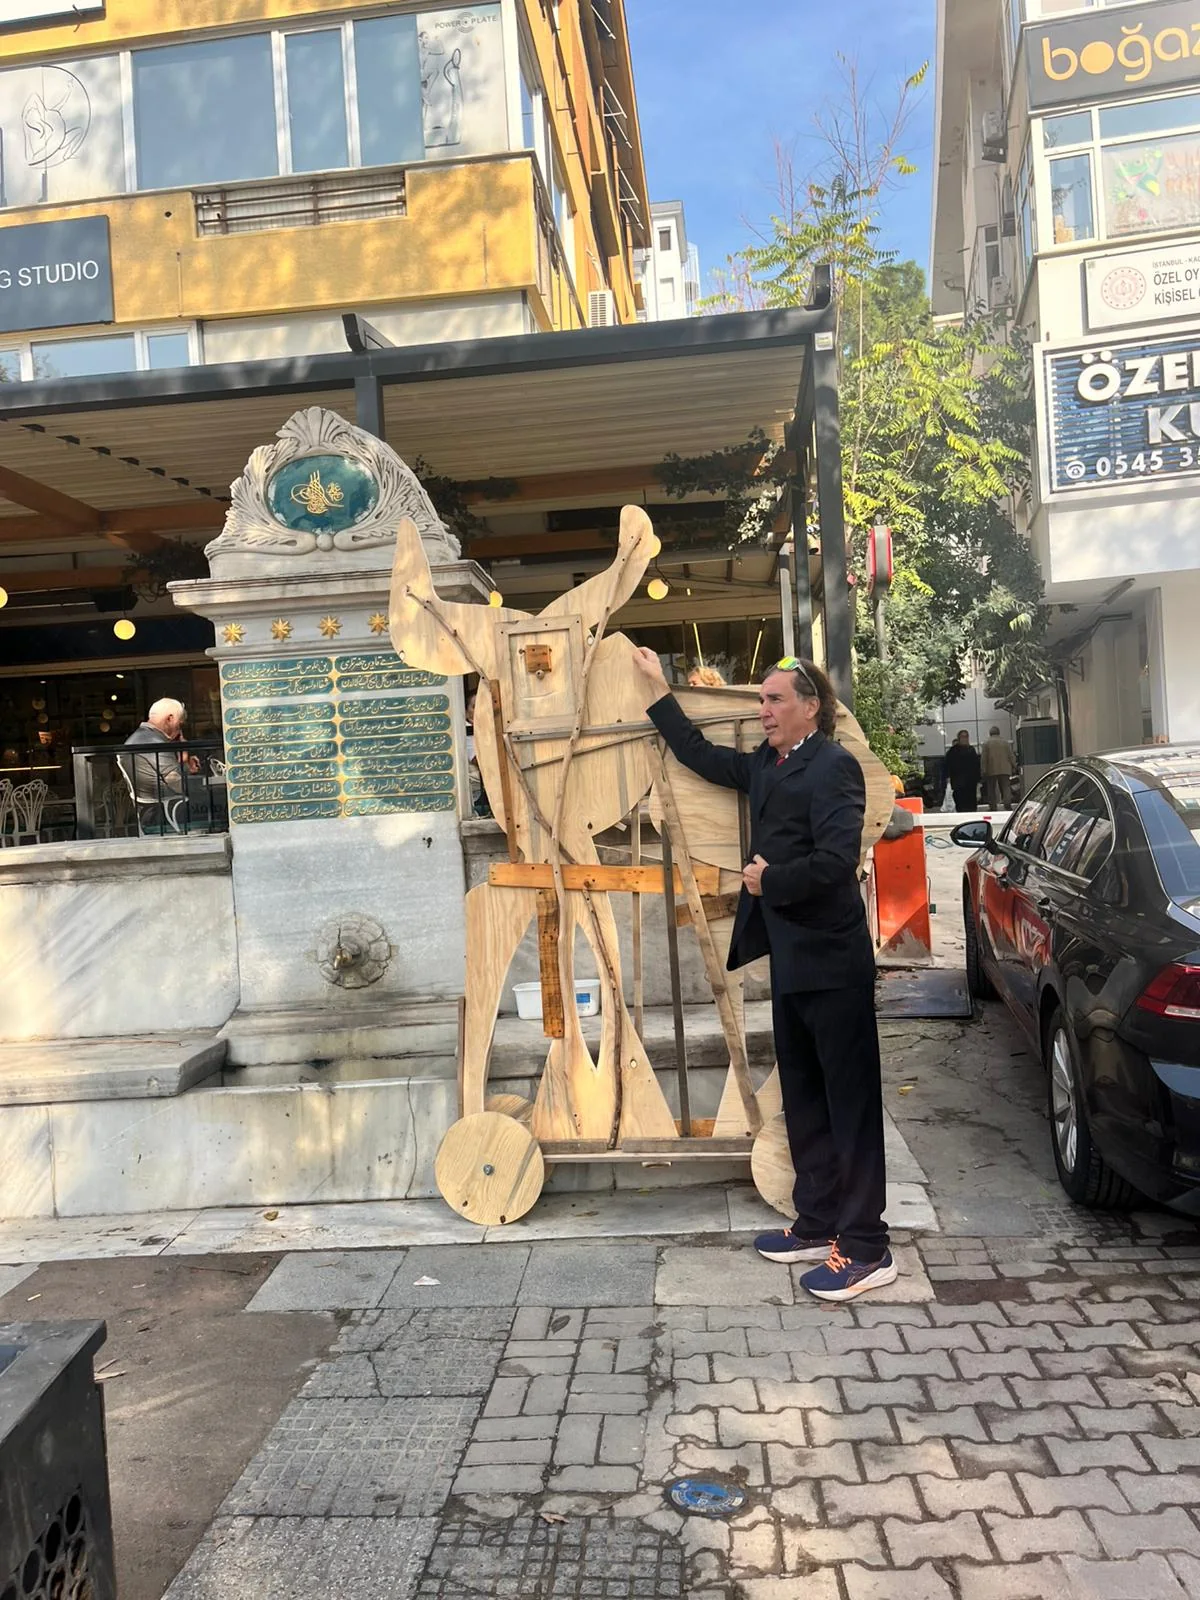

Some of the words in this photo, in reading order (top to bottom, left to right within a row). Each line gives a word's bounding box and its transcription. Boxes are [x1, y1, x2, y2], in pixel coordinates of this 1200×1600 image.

[435, 20, 461, 29] POWER
[470, 15, 497, 24] PLATE
[18, 259, 99, 287] STUDIO
[1153, 270, 1182, 286] ÖZEL
[1154, 287, 1196, 306] KİŞİSEL
[1096, 449, 1164, 477] 0545
[1179, 446, 1200, 467] 3
